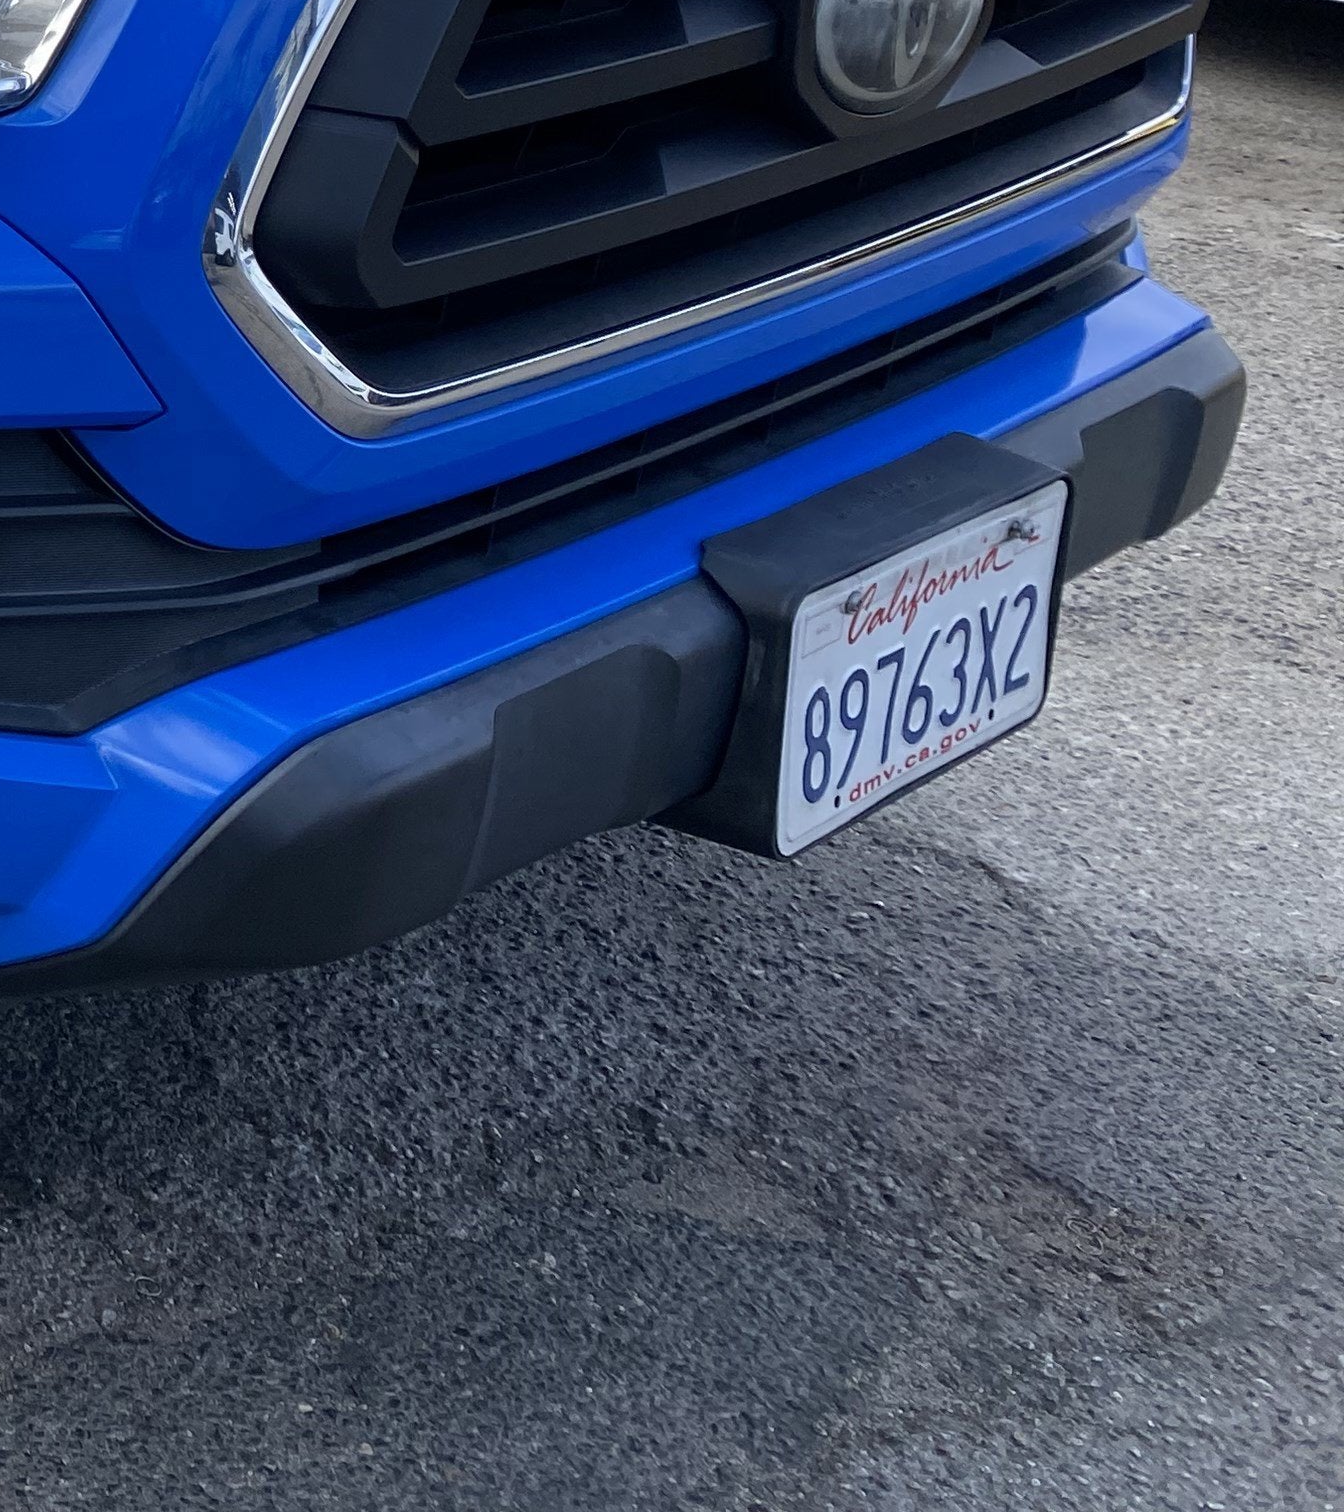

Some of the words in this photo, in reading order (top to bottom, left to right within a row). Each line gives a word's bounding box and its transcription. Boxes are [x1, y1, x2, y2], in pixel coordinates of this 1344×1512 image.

[847, 536, 1014, 645] California
[802, 583, 1038, 804] 89763X2
[849, 717, 982, 803] dmv.ca.gov
